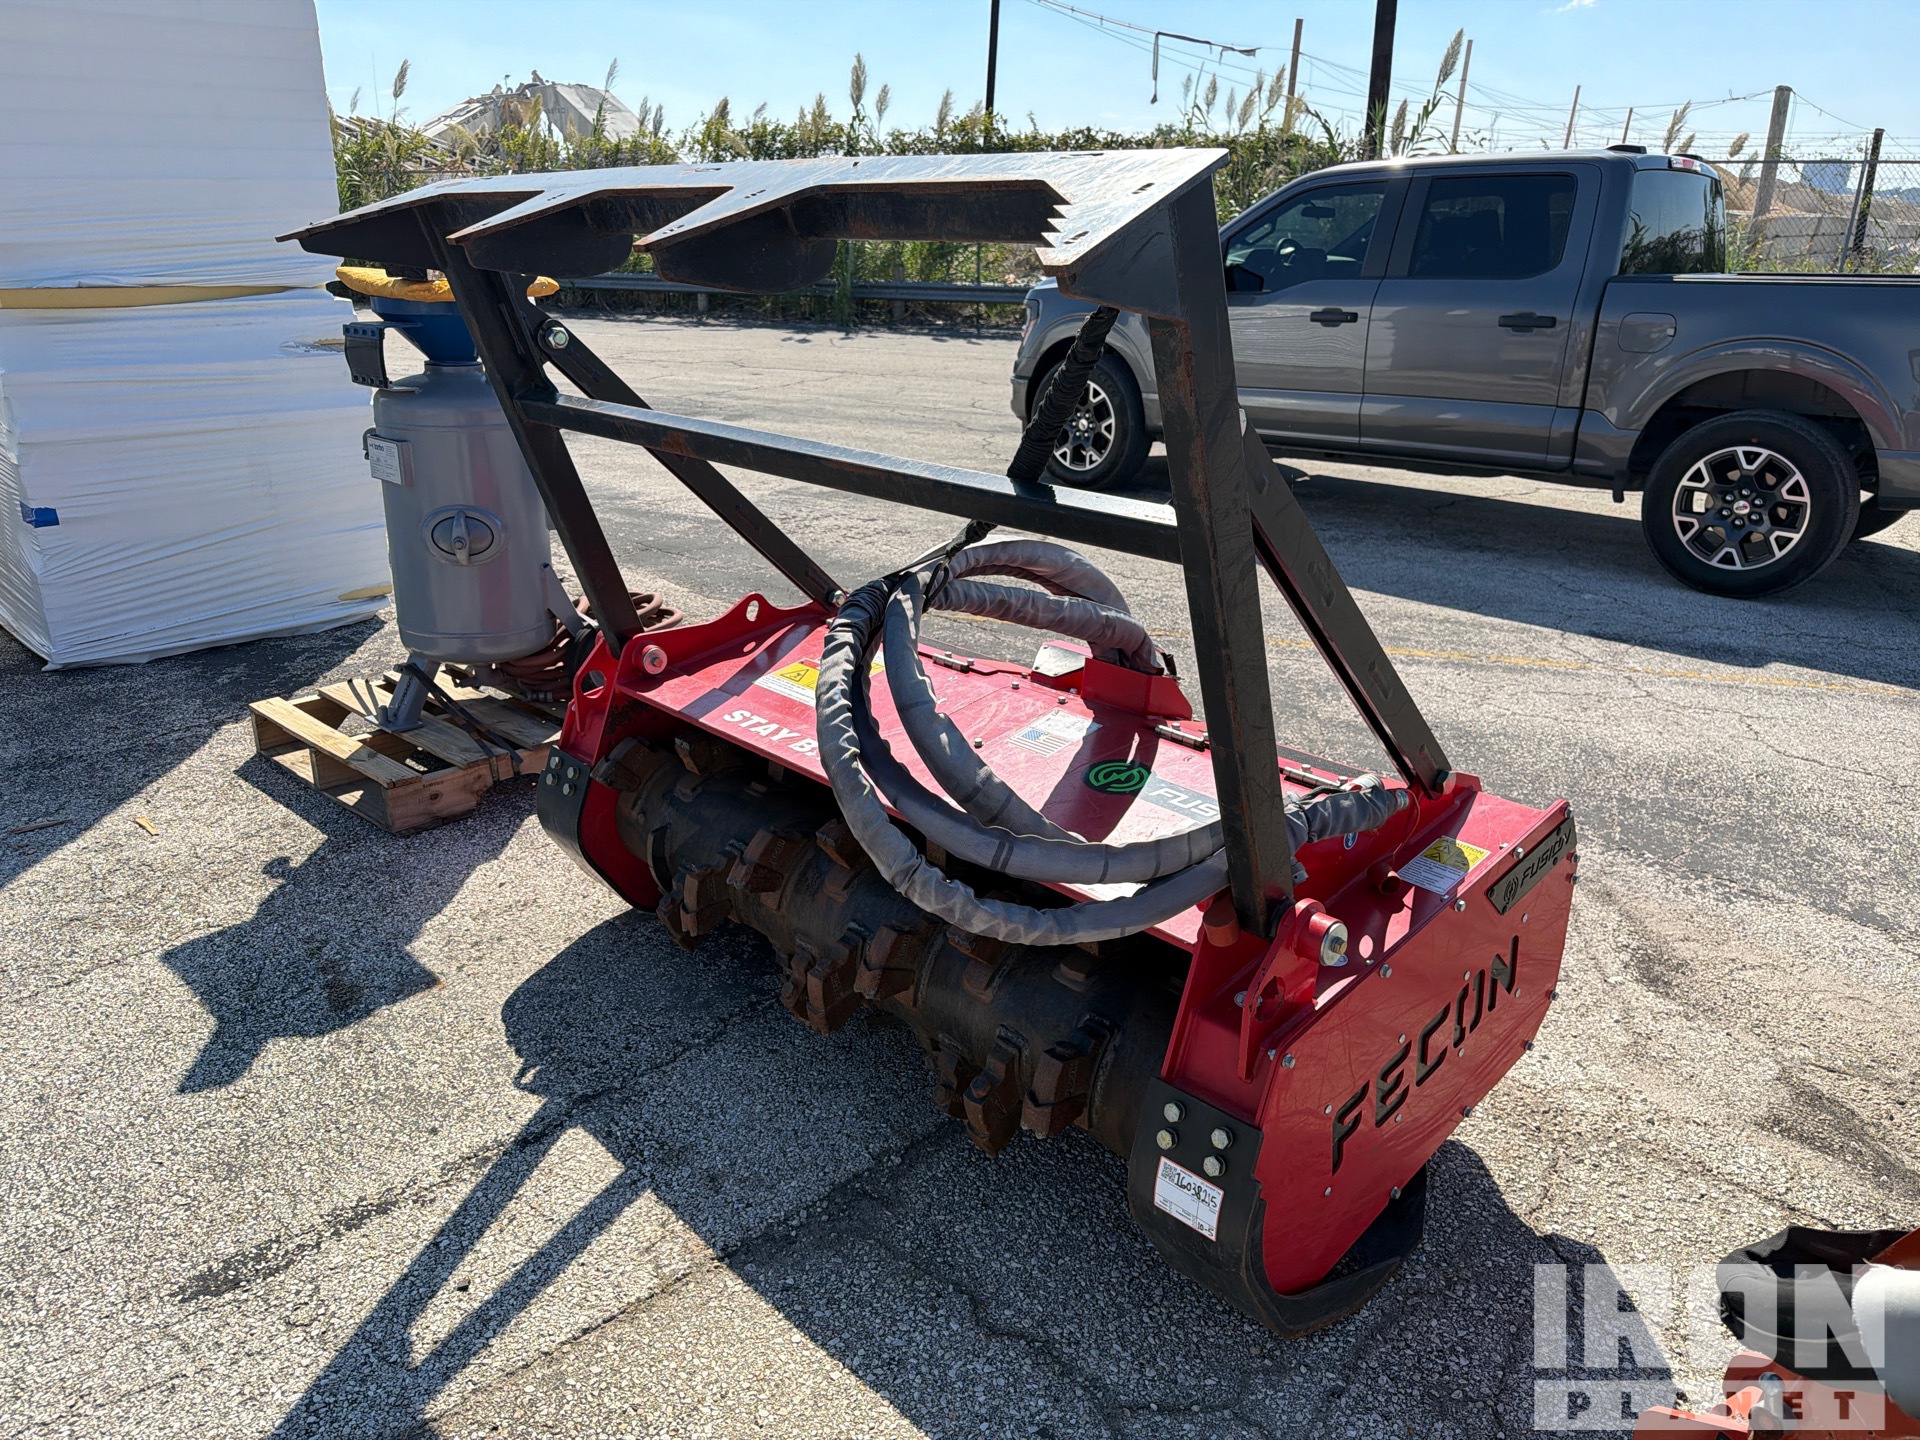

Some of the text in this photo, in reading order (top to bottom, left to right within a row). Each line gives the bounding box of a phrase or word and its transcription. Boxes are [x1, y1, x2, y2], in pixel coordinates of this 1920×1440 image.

[723, 709, 801, 742] STAY
[1449, 839, 1484, 855] CAUTION
[1520, 828, 1571, 887] FUSION
[1331, 934, 1519, 1177] FECON
